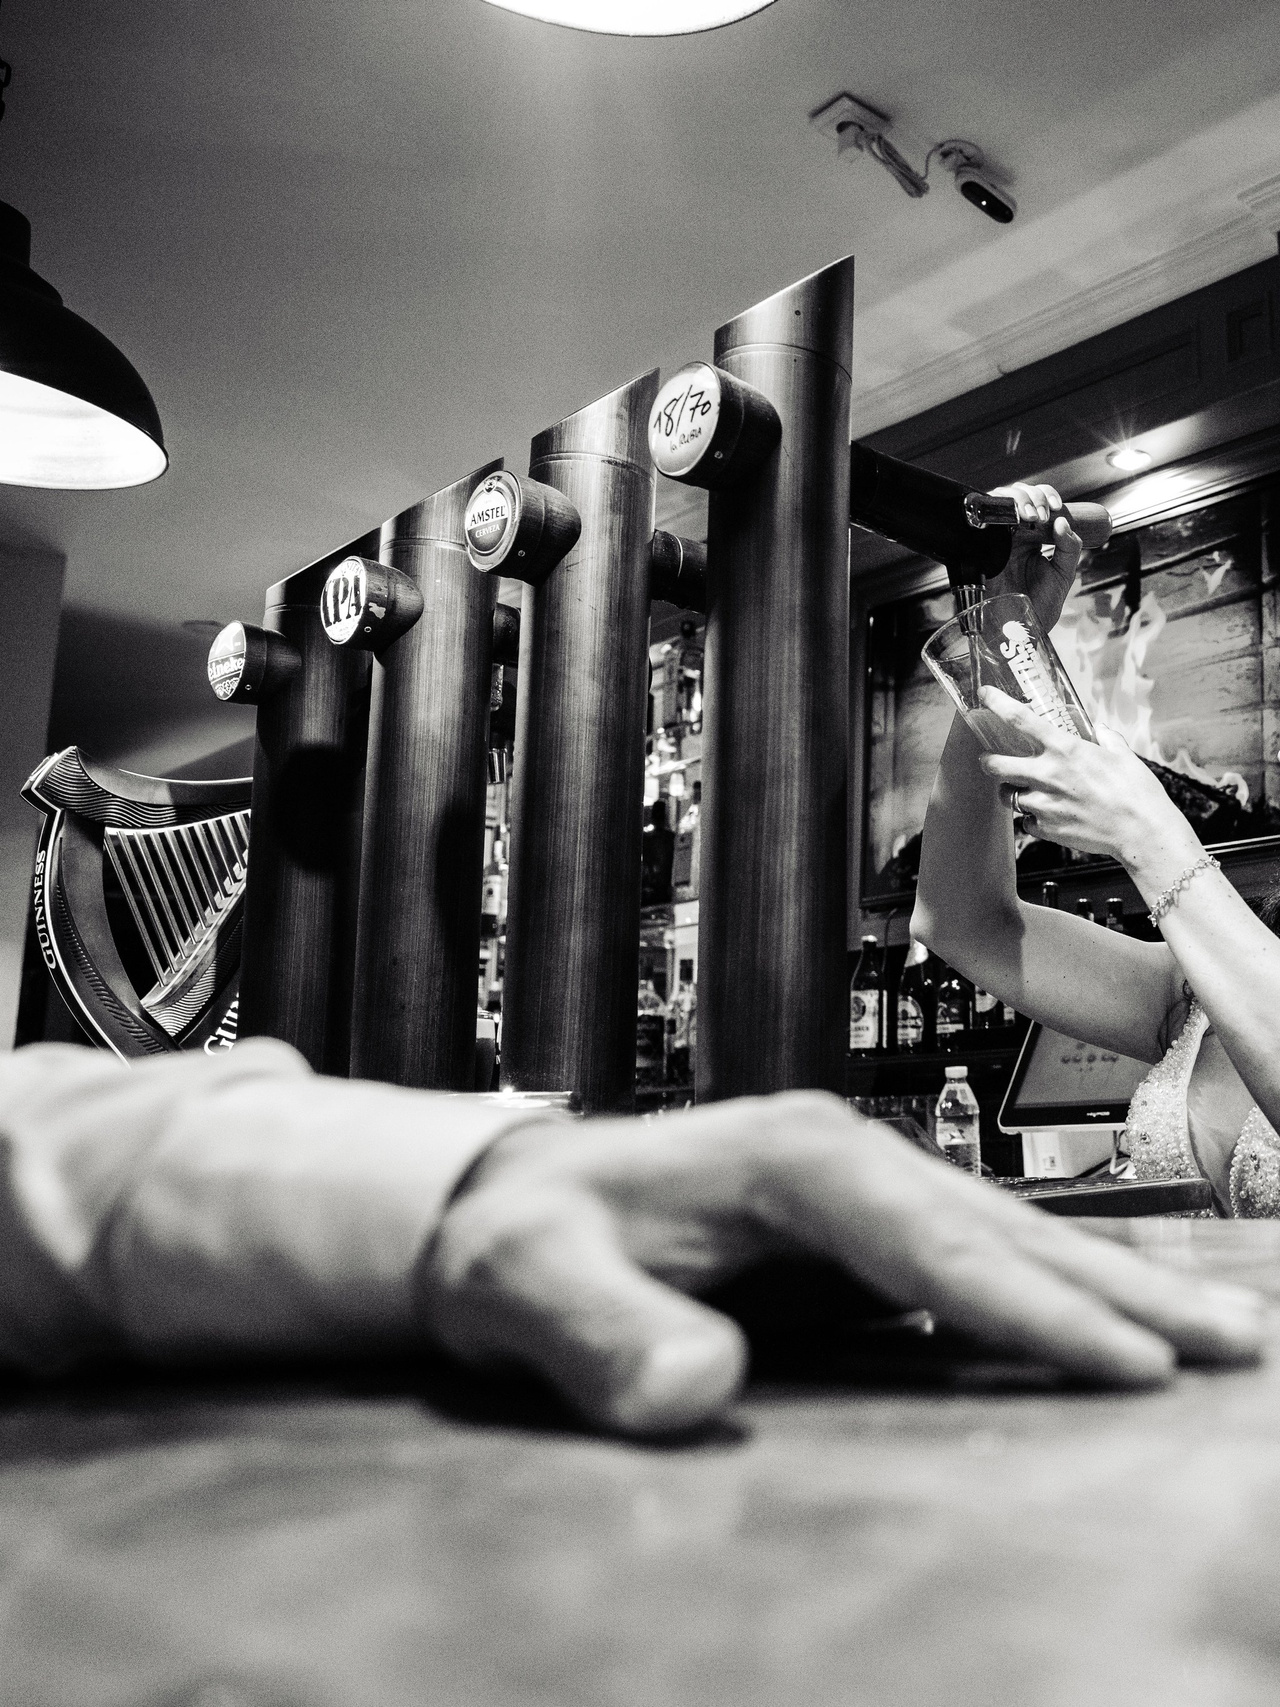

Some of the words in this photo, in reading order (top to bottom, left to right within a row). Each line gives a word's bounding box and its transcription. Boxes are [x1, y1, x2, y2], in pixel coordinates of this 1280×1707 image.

[653, 383, 711, 437] 18/70
[470, 506, 505, 526] AMSTEL
[475, 523, 500, 539] CERVEZA
[322, 576, 362, 629] IPA
[34, 849, 57, 970] GUINNESS
